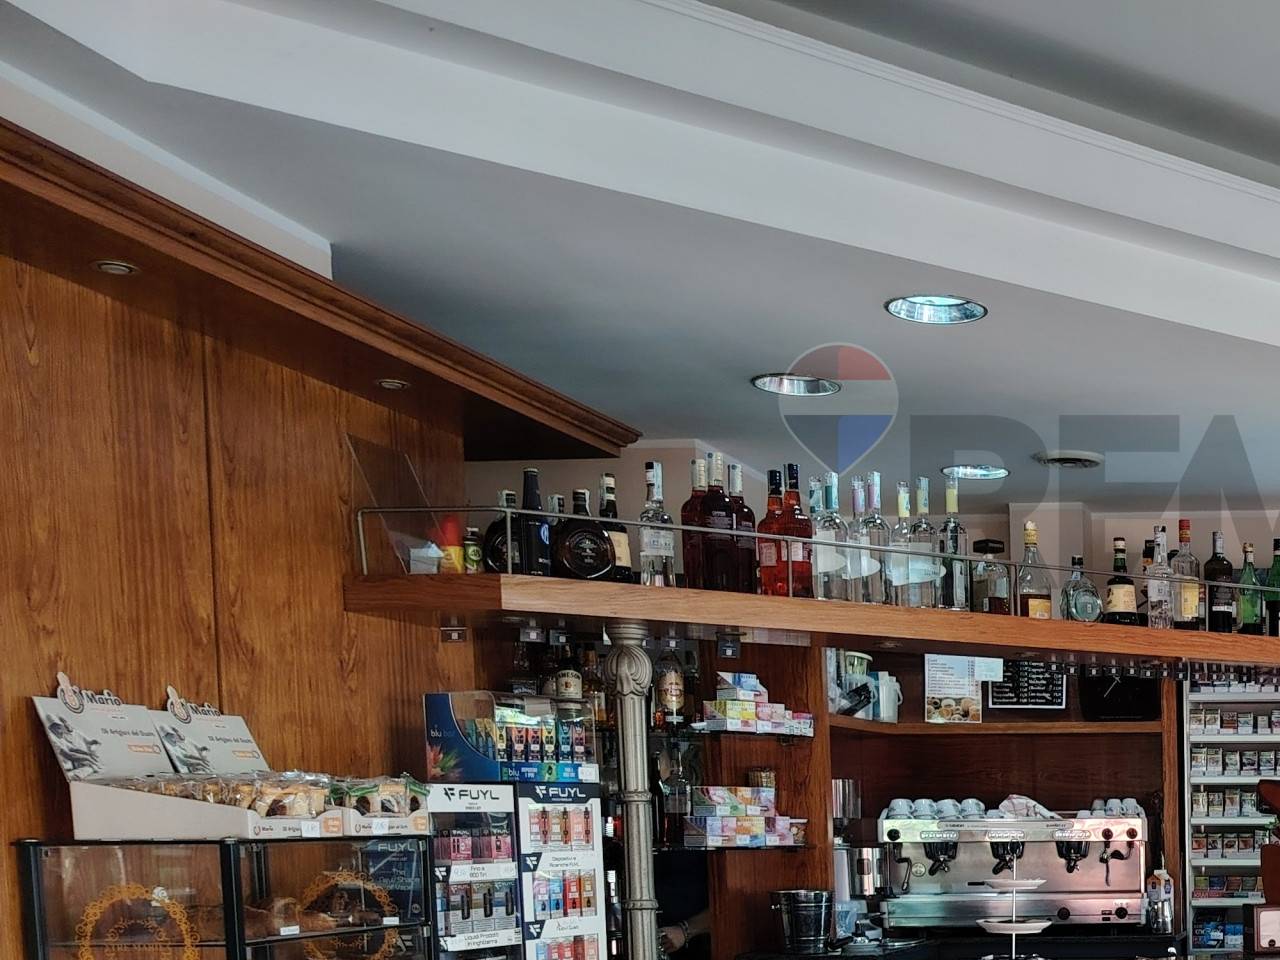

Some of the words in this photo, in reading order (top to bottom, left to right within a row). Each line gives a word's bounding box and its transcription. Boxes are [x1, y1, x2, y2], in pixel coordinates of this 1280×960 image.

[86, 692, 121, 706] Mario
[190, 703, 221, 717] Mario
[430, 728, 442, 738] blu
[508, 767, 520, 777] blu
[458, 789, 500, 801] FUYL
[549, 787, 586, 798] FUYL
[377, 843, 417, 852] FUYL
